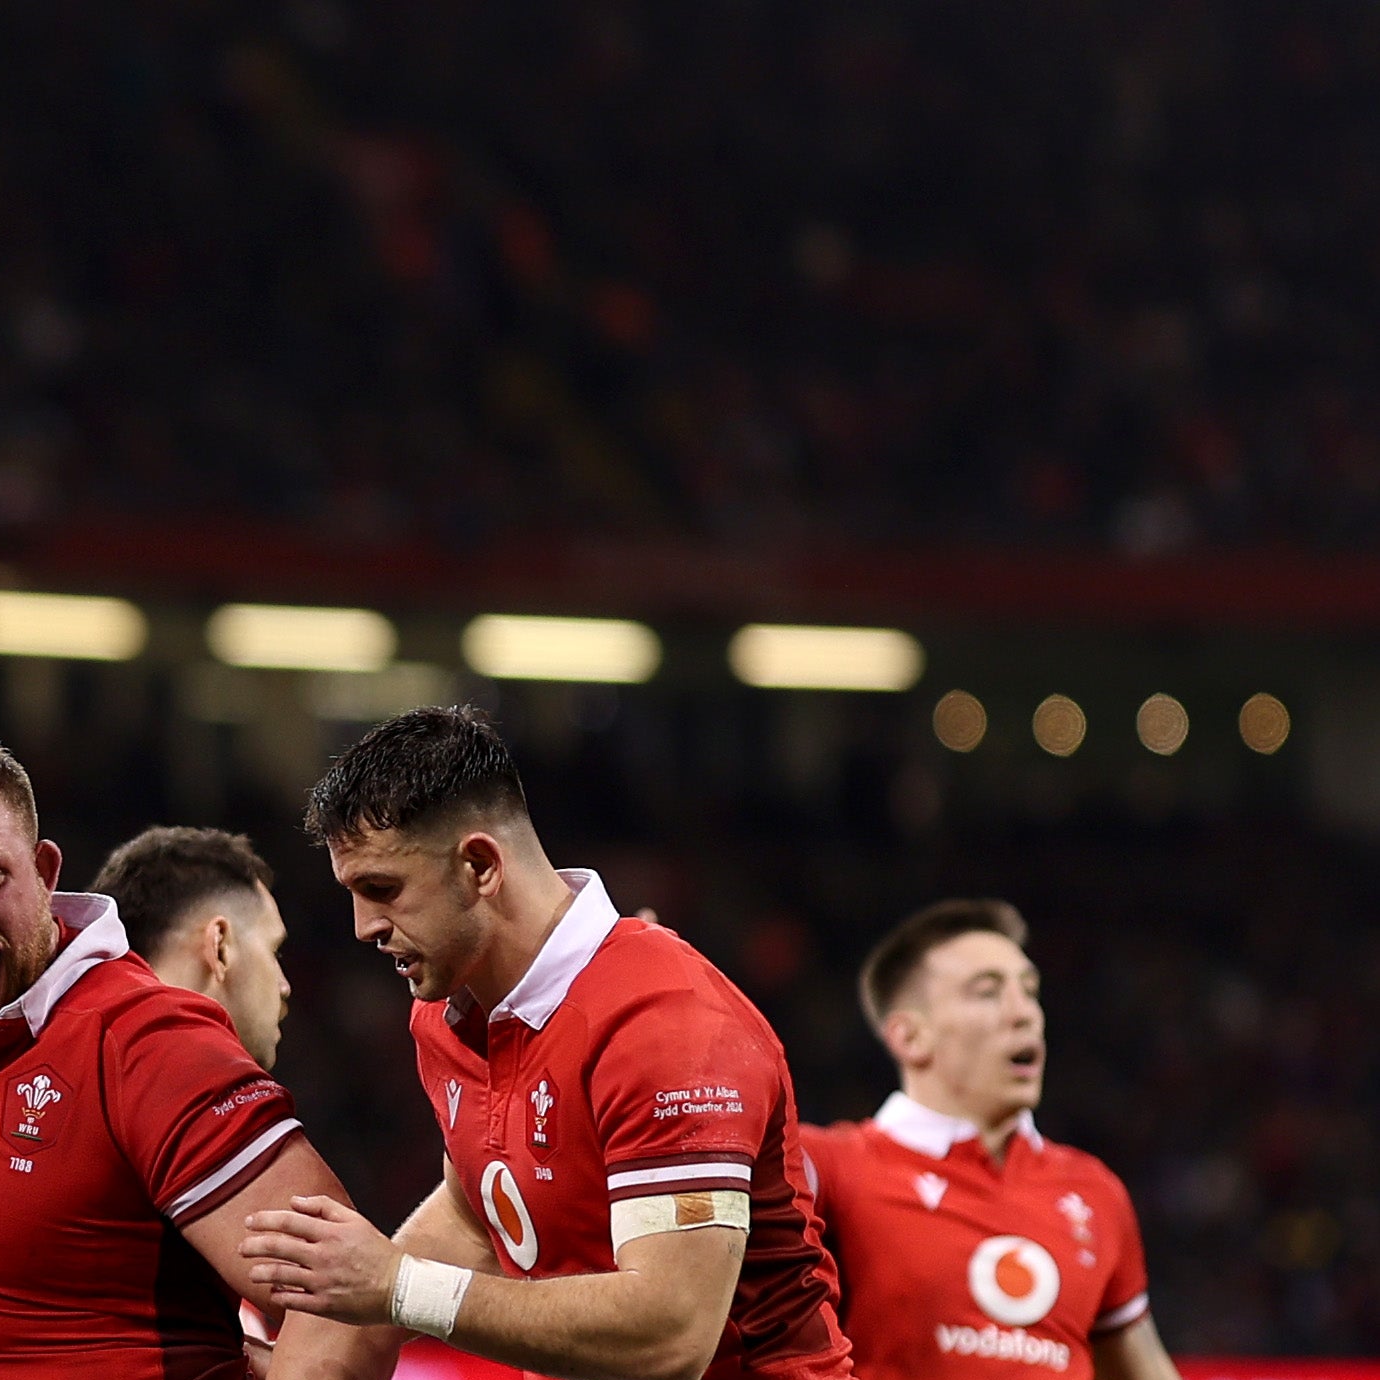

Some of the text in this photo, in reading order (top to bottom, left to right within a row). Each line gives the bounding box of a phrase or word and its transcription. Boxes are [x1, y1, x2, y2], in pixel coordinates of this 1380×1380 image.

[655, 1085, 740, 1105] Cymru v Yr Alban
[653, 1104, 679, 1120] 3ydd
[681, 1100, 724, 1114] Chwefror
[18, 1123, 39, 1136] WRU
[935, 1321, 1071, 1373] vodafone
